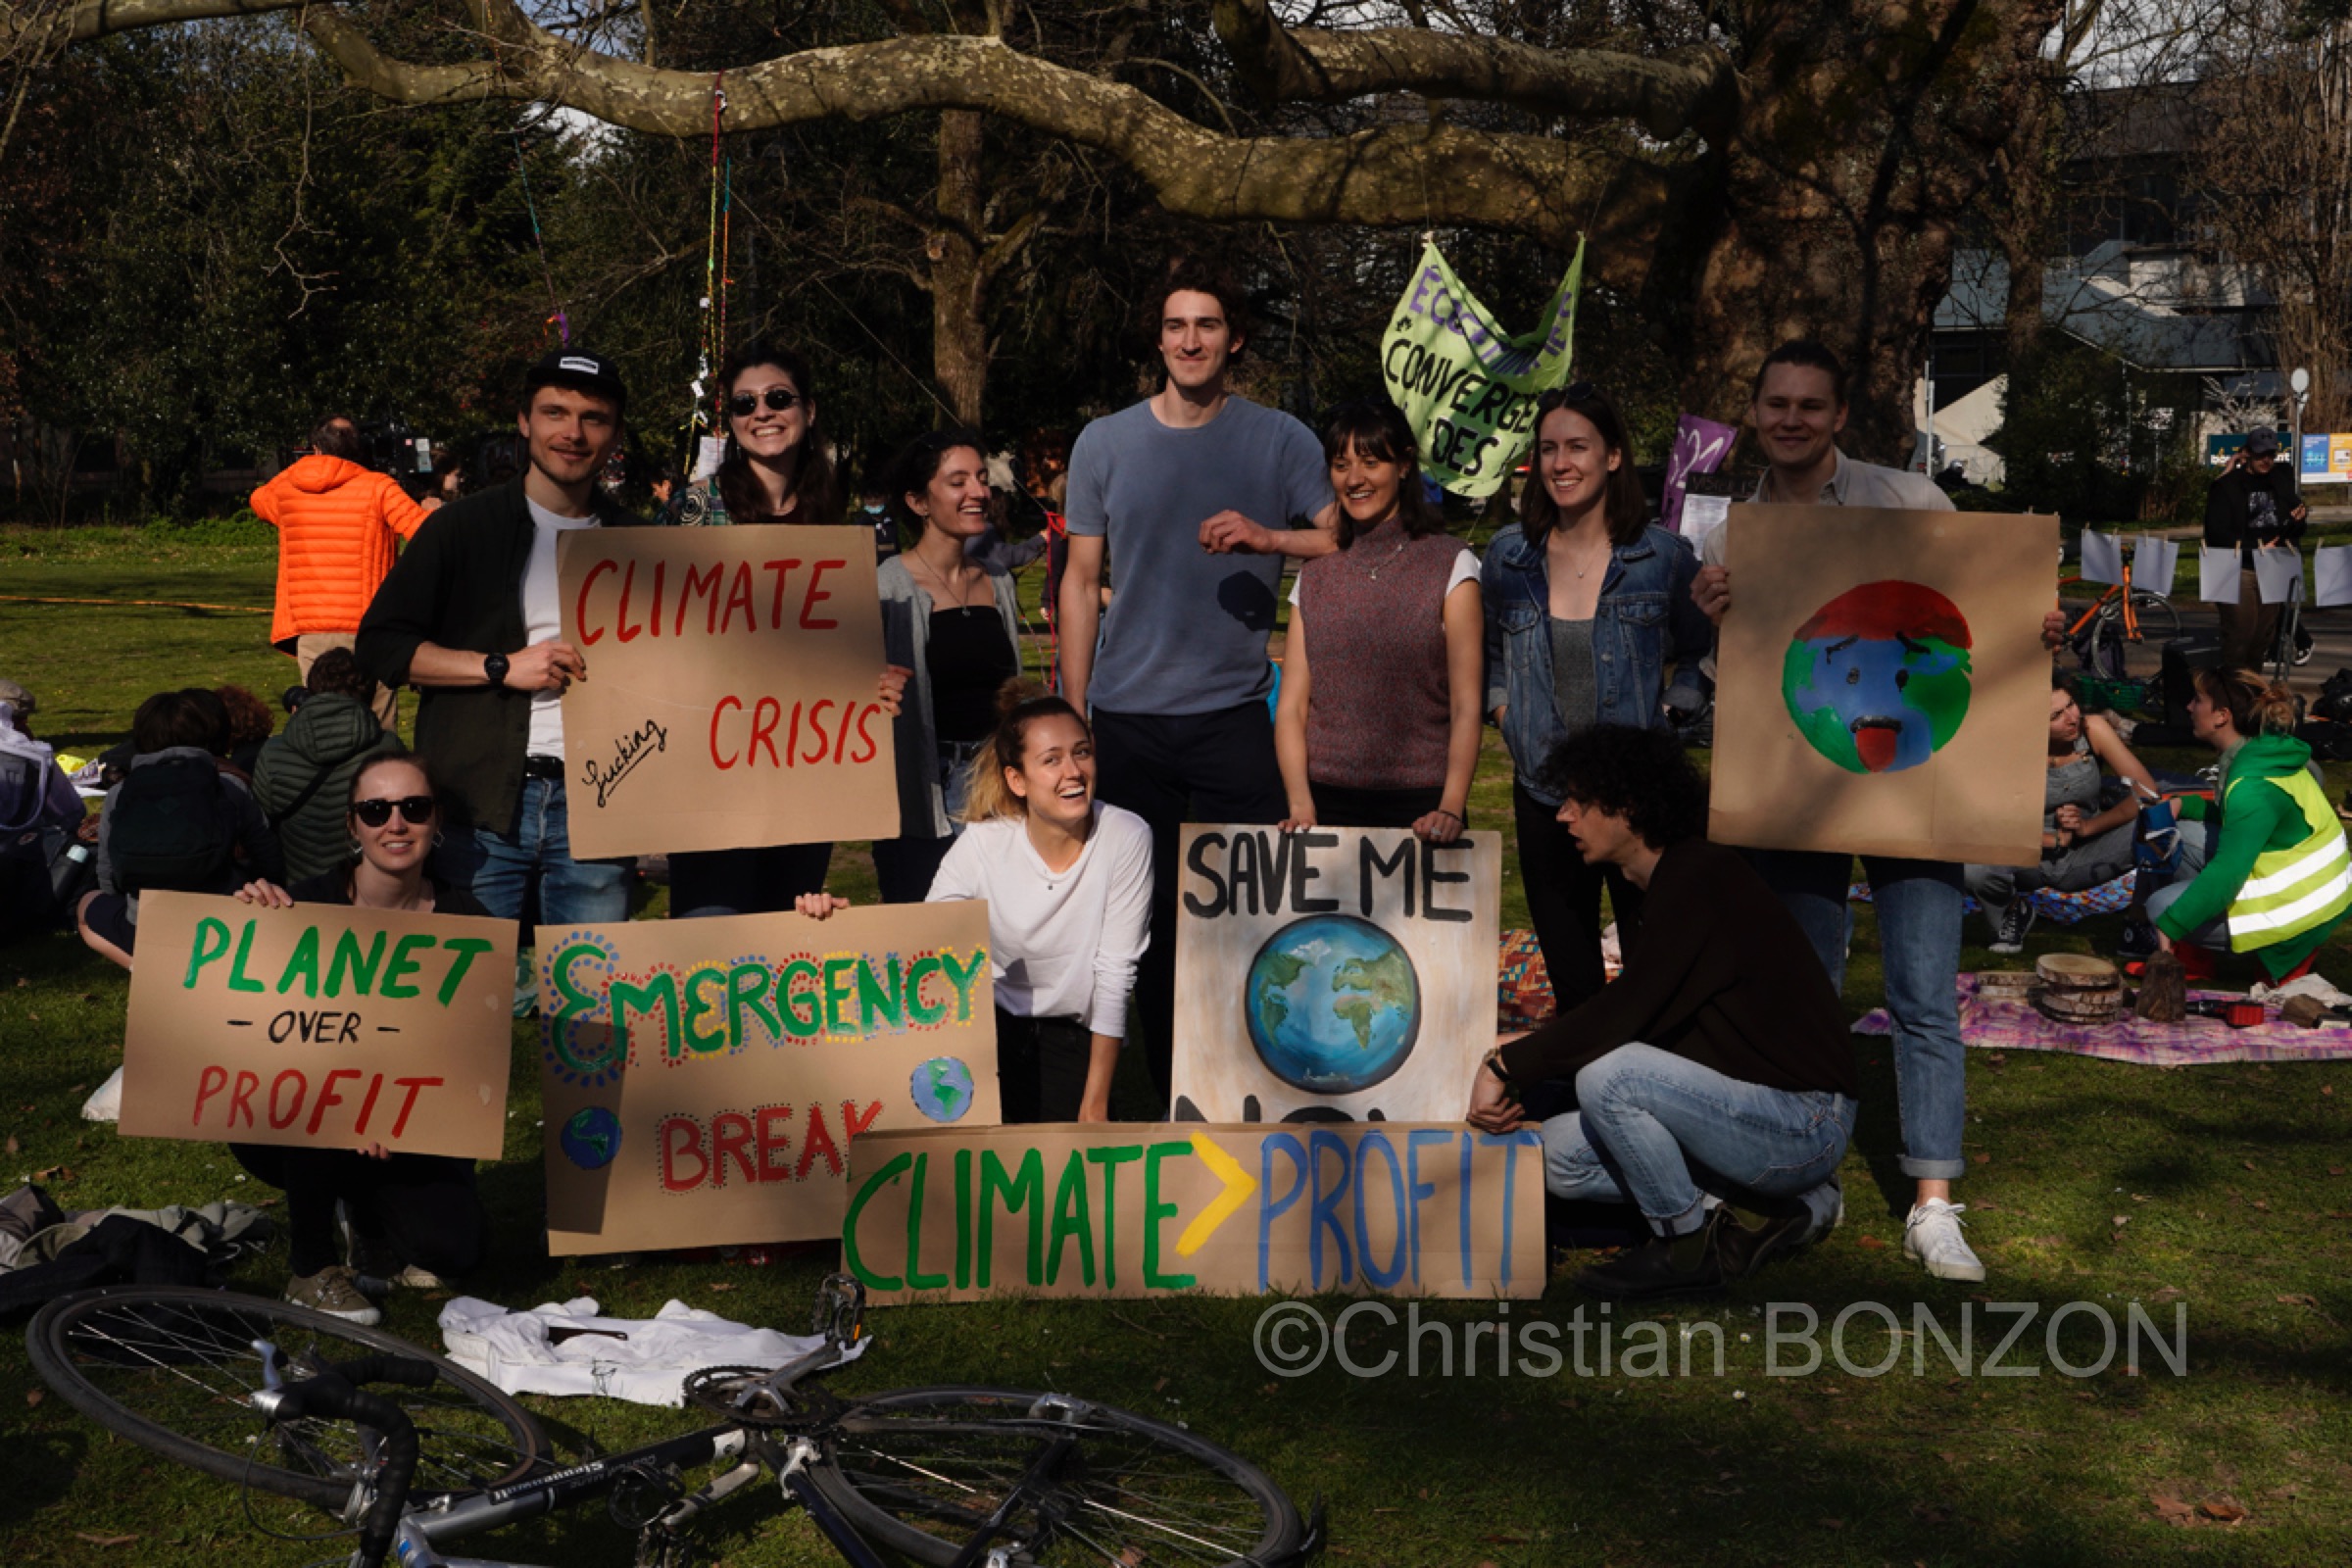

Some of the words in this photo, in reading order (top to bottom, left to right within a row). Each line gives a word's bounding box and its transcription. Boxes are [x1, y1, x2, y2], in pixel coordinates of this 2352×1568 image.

[1385, 338, 1537, 434] CONVERGE
[1432, 418, 1499, 476] DES
[576, 558, 847, 646] CLIMATE
[710, 695, 881, 770] CRISIS
[1183, 830, 1340, 919] SAVE
[1359, 835, 1475, 922] ME
[183, 916, 493, 1007] PLANET
[268, 1010, 362, 1044] OVER
[547, 938, 987, 1076] EMERGENCY
[192, 1064, 444, 1139] PROFIT
[843, 1141, 1197, 1292] CLIMATE
[1258, 1129, 1544, 1294] PROFIT
